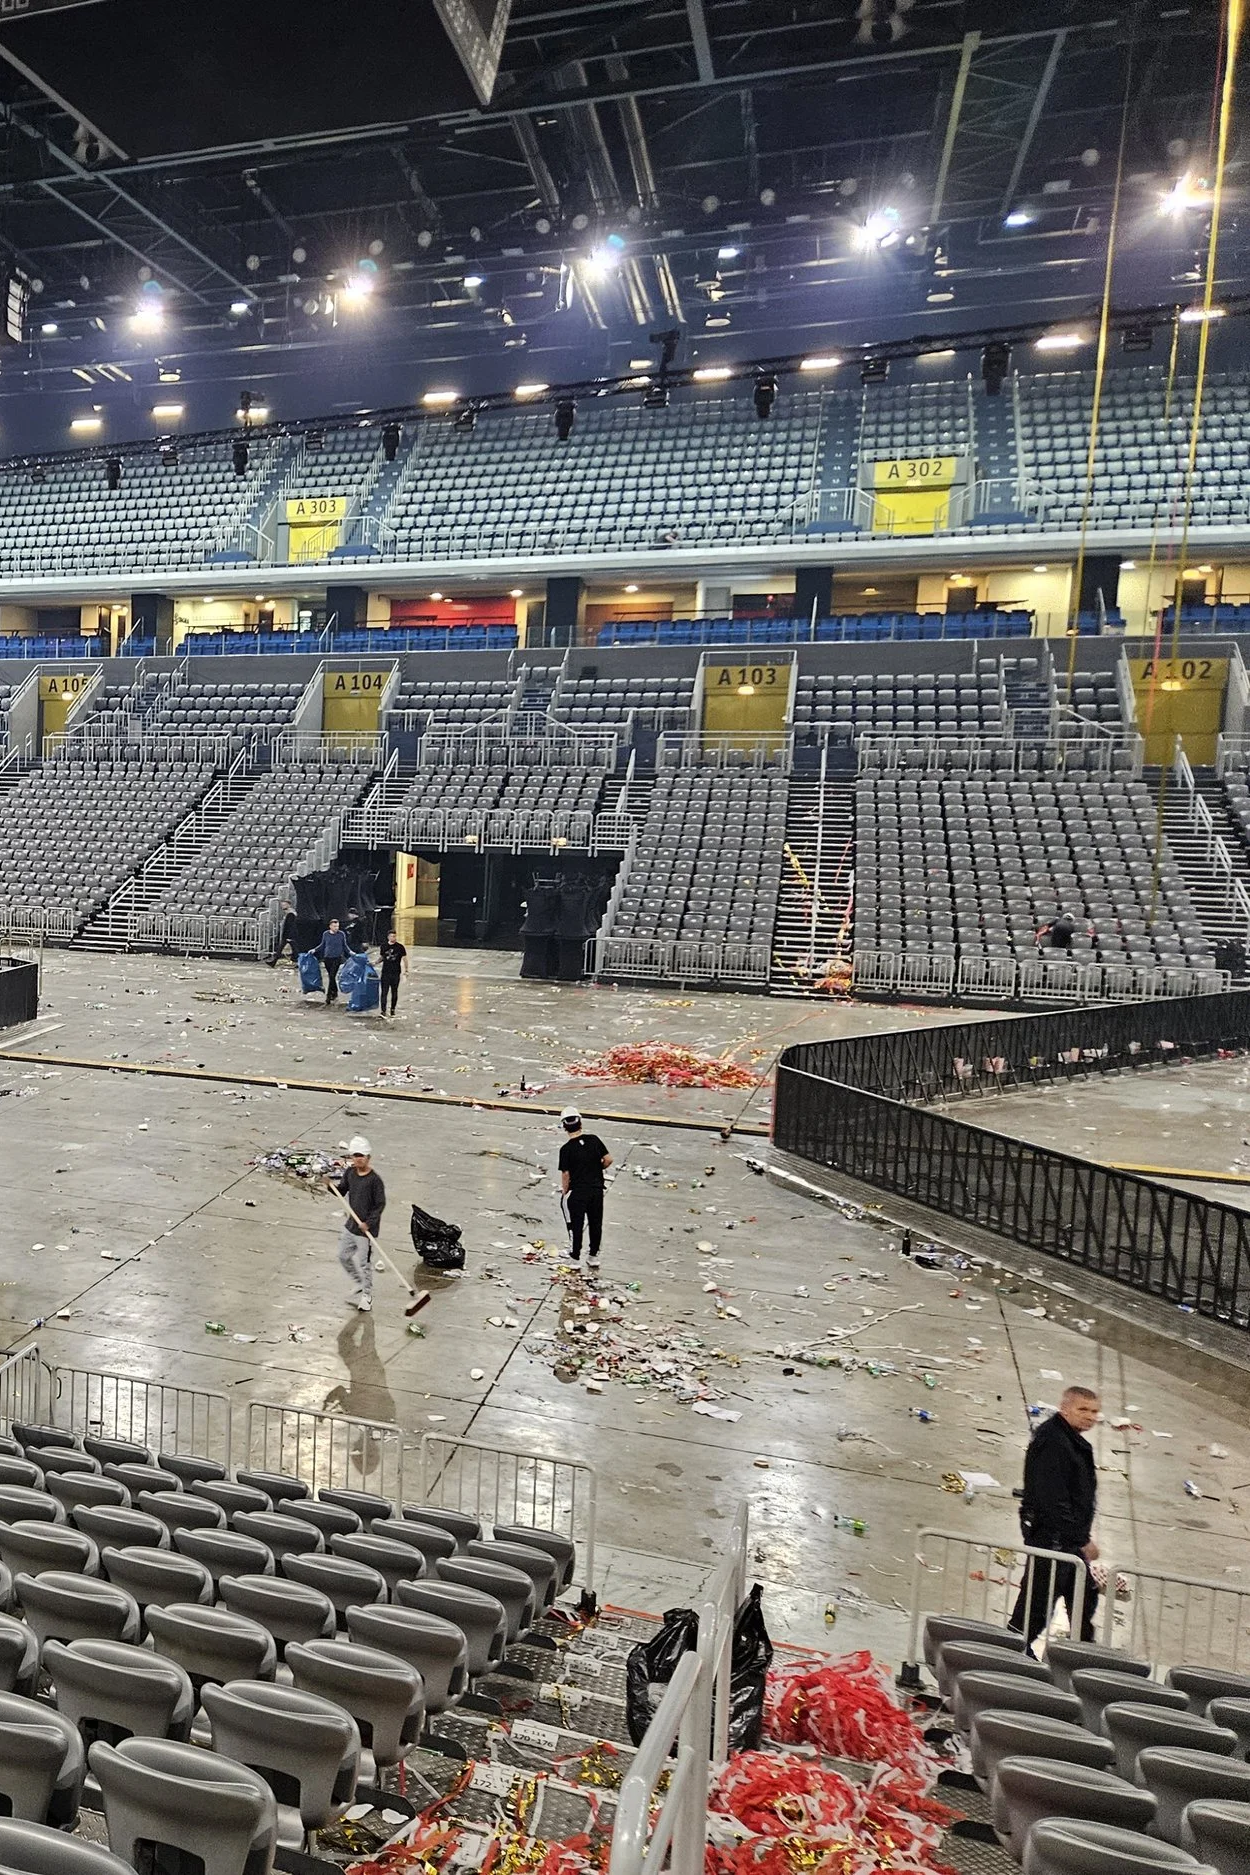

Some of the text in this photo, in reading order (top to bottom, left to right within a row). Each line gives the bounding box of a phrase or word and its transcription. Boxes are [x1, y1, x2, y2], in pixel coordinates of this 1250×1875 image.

[887, 461, 943, 479] A 302
[296, 499, 336, 515] A 303
[717, 668, 776, 686] A 103
[1141, 660, 1212, 680] A 102
[48, 678, 58, 693] A
[335, 674, 383, 690] A 104
